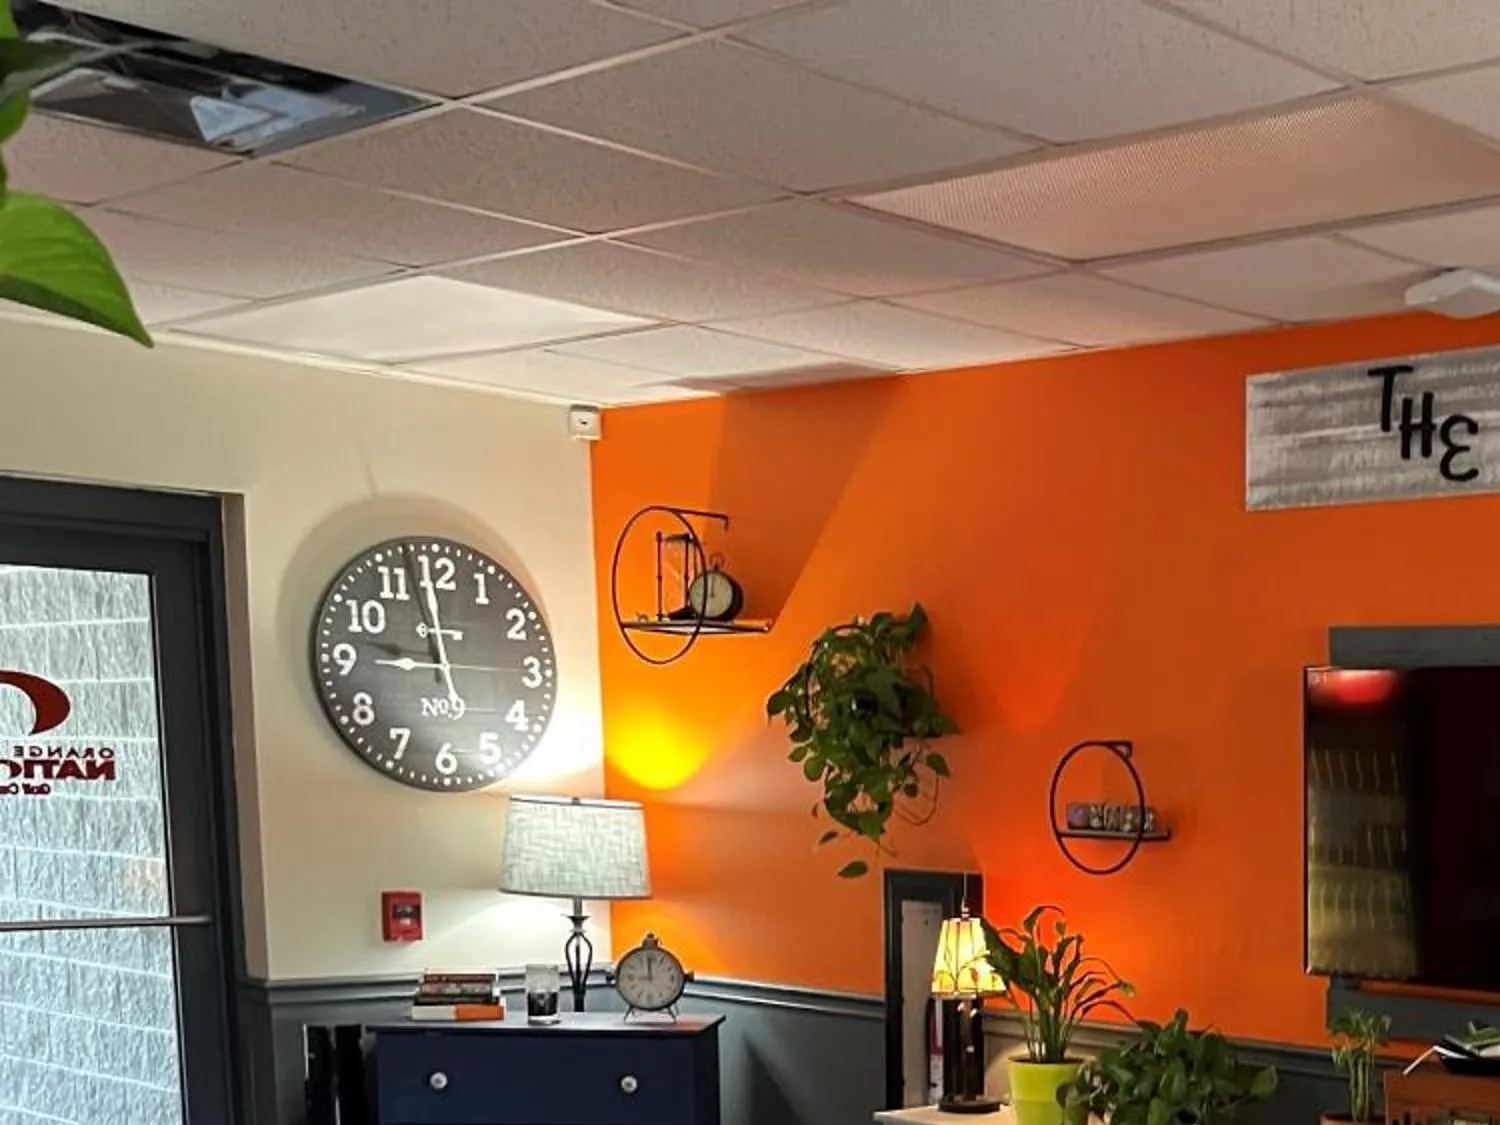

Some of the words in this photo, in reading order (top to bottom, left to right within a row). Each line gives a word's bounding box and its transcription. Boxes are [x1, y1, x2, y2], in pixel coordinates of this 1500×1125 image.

[1368, 364, 1479, 482] THE
[378, 566, 410, 601] 11
[418, 555, 456, 590] 12
[473, 573, 489, 605] 1
[345, 599, 386, 634] 10
[505, 609, 527, 640] 2
[332, 643, 357, 675] 9
[521, 656, 543, 688] 3
[353, 692, 375, 725] 8
[505, 700, 529, 731] 4
[389, 727, 411, 759] 7
[435, 743, 457, 774] 6
[479, 732, 501, 764] 5
